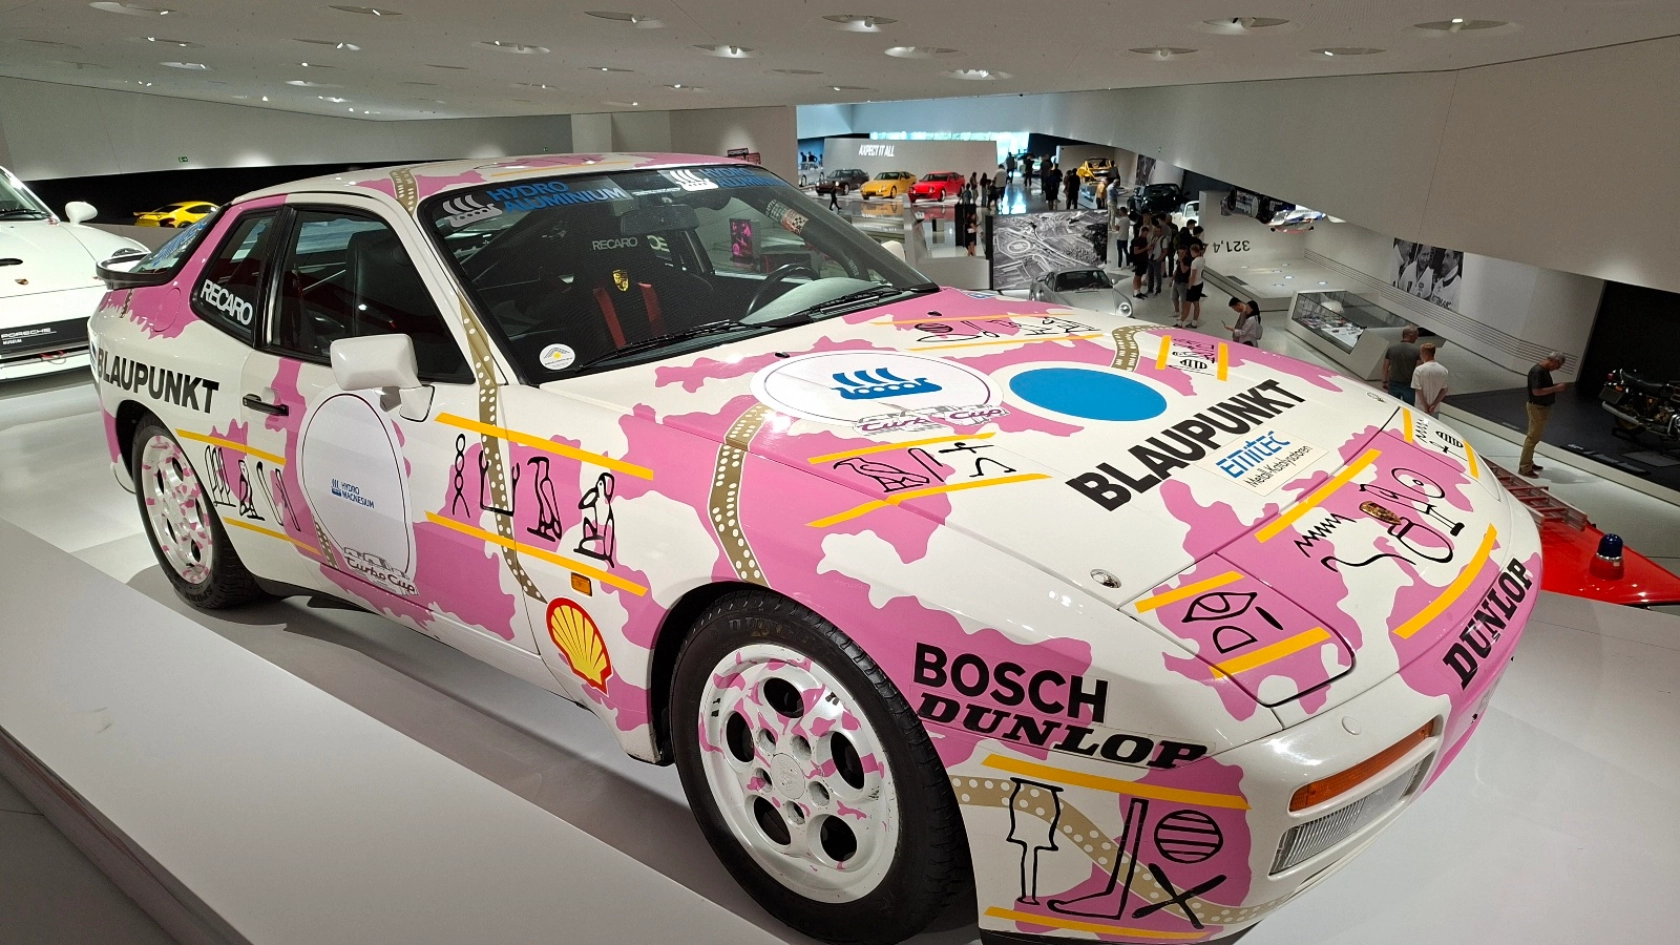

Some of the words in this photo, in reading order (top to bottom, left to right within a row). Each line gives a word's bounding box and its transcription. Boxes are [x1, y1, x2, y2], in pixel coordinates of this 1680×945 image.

[486, 181, 569, 201] HYDRO
[504, 187, 627, 213] ALUMINIUM
[592, 237, 638, 250] RECARO
[200, 279, 254, 327] RECARO
[1, 328, 51, 338] PORSCHE
[98, 347, 220, 414] BLAUPUNKT
[858, 416, 934, 432] Turb
[950, 409, 1001, 420] Cup
[1064, 379, 1306, 512] BLAUPUNKT
[341, 482, 360, 495] HYDRO
[341, 490, 375, 509] MAGNESIUM
[344, 556, 386, 580] Turbo
[387, 573, 415, 591] Cup
[1442, 557, 1533, 691] DUNLOP
[914, 642, 1109, 724] BOSCH
[917, 692, 1208, 769] DUNLOP
